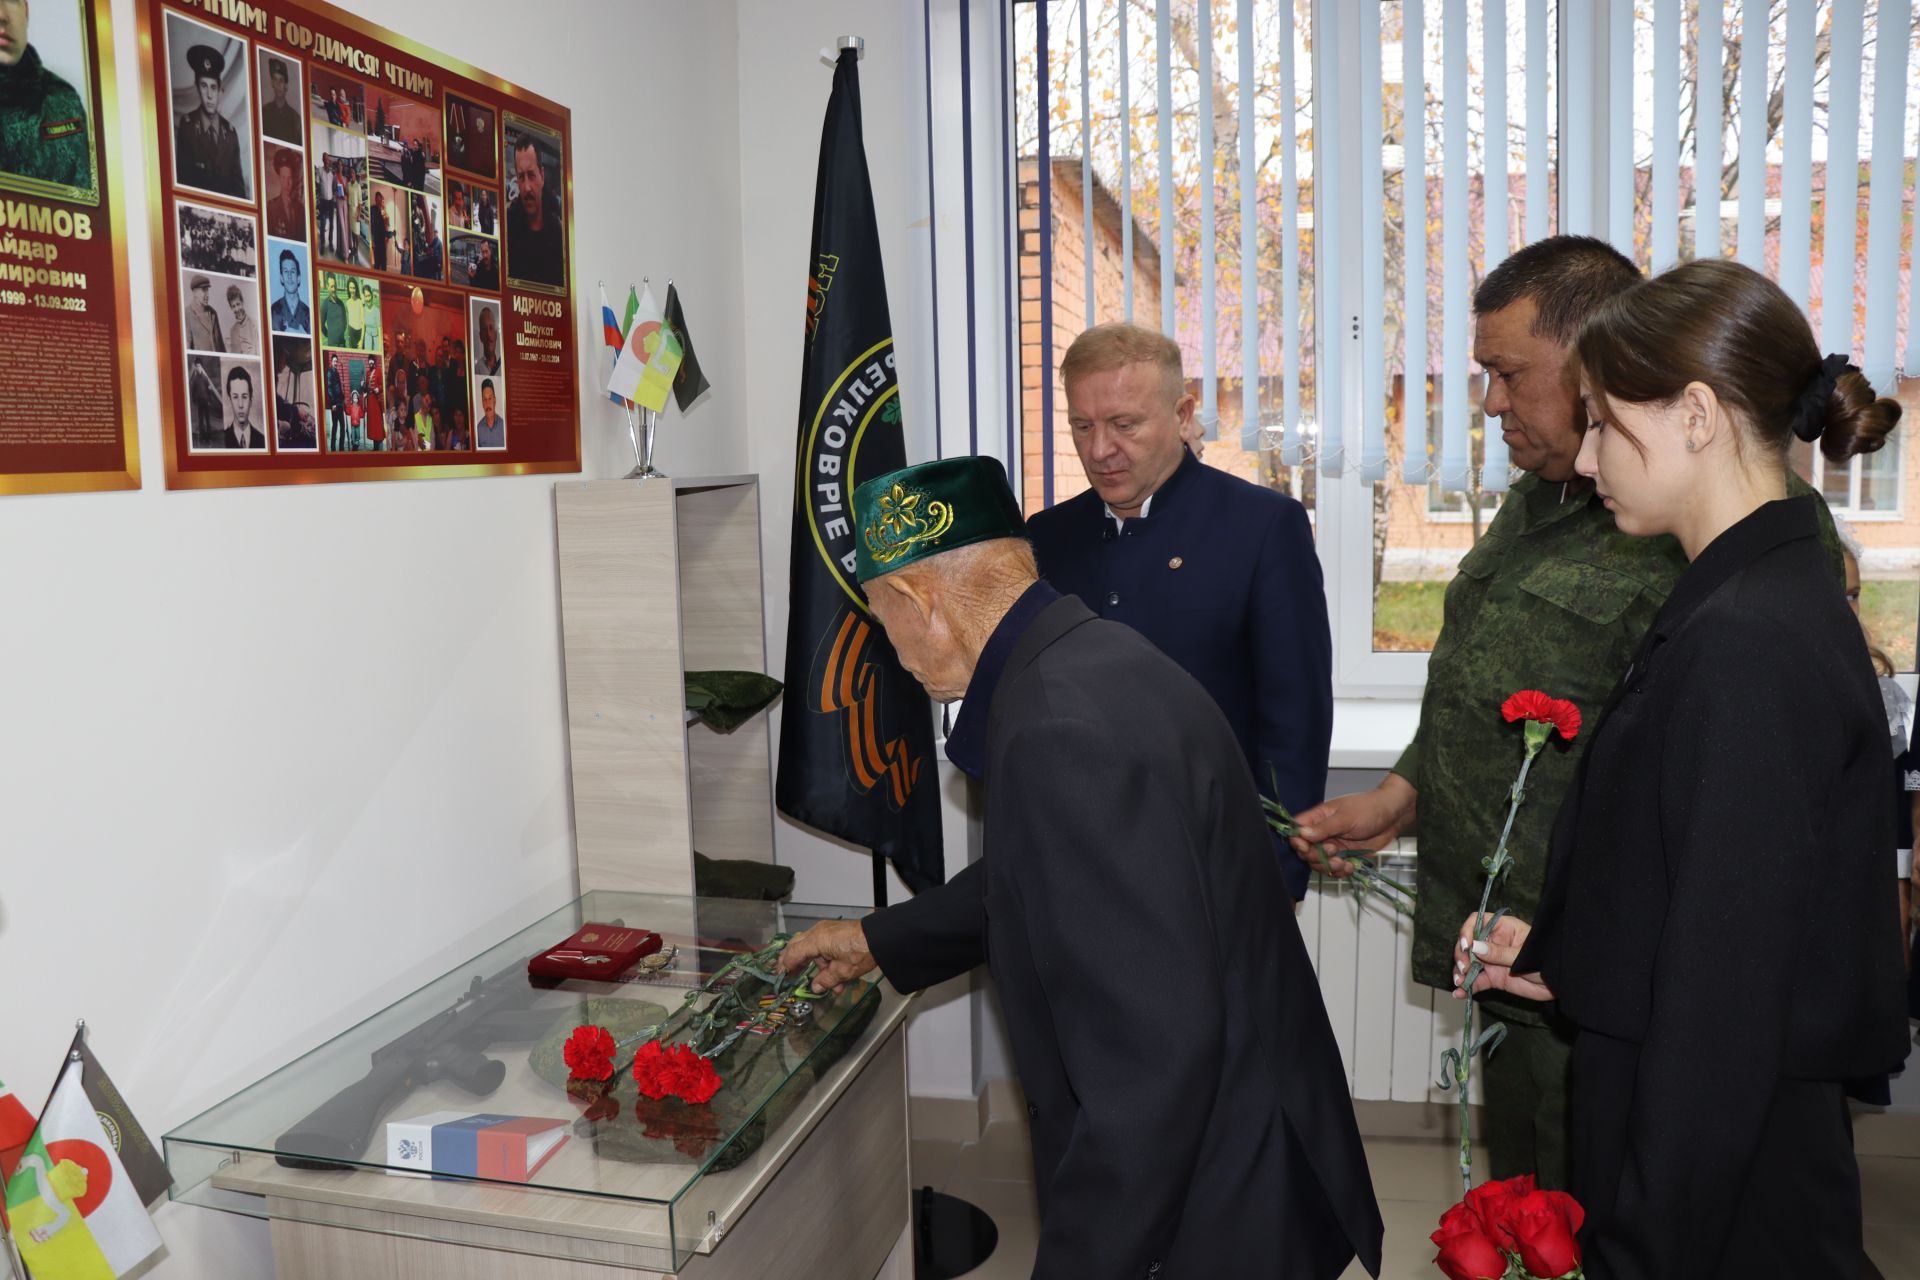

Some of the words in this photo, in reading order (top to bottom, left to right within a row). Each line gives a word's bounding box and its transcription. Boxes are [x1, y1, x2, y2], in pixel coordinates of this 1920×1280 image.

[274, 15, 380, 79] ГОРДИМСЯ!
[384, 60, 434, 99] ЧТИМ!
[34, 294, 87, 312] 13.09.2022
[513, 294, 563, 318] ИДРИСОВ
[523, 320, 554, 338] Шаукат
[516, 332, 562, 350] Шамилович
